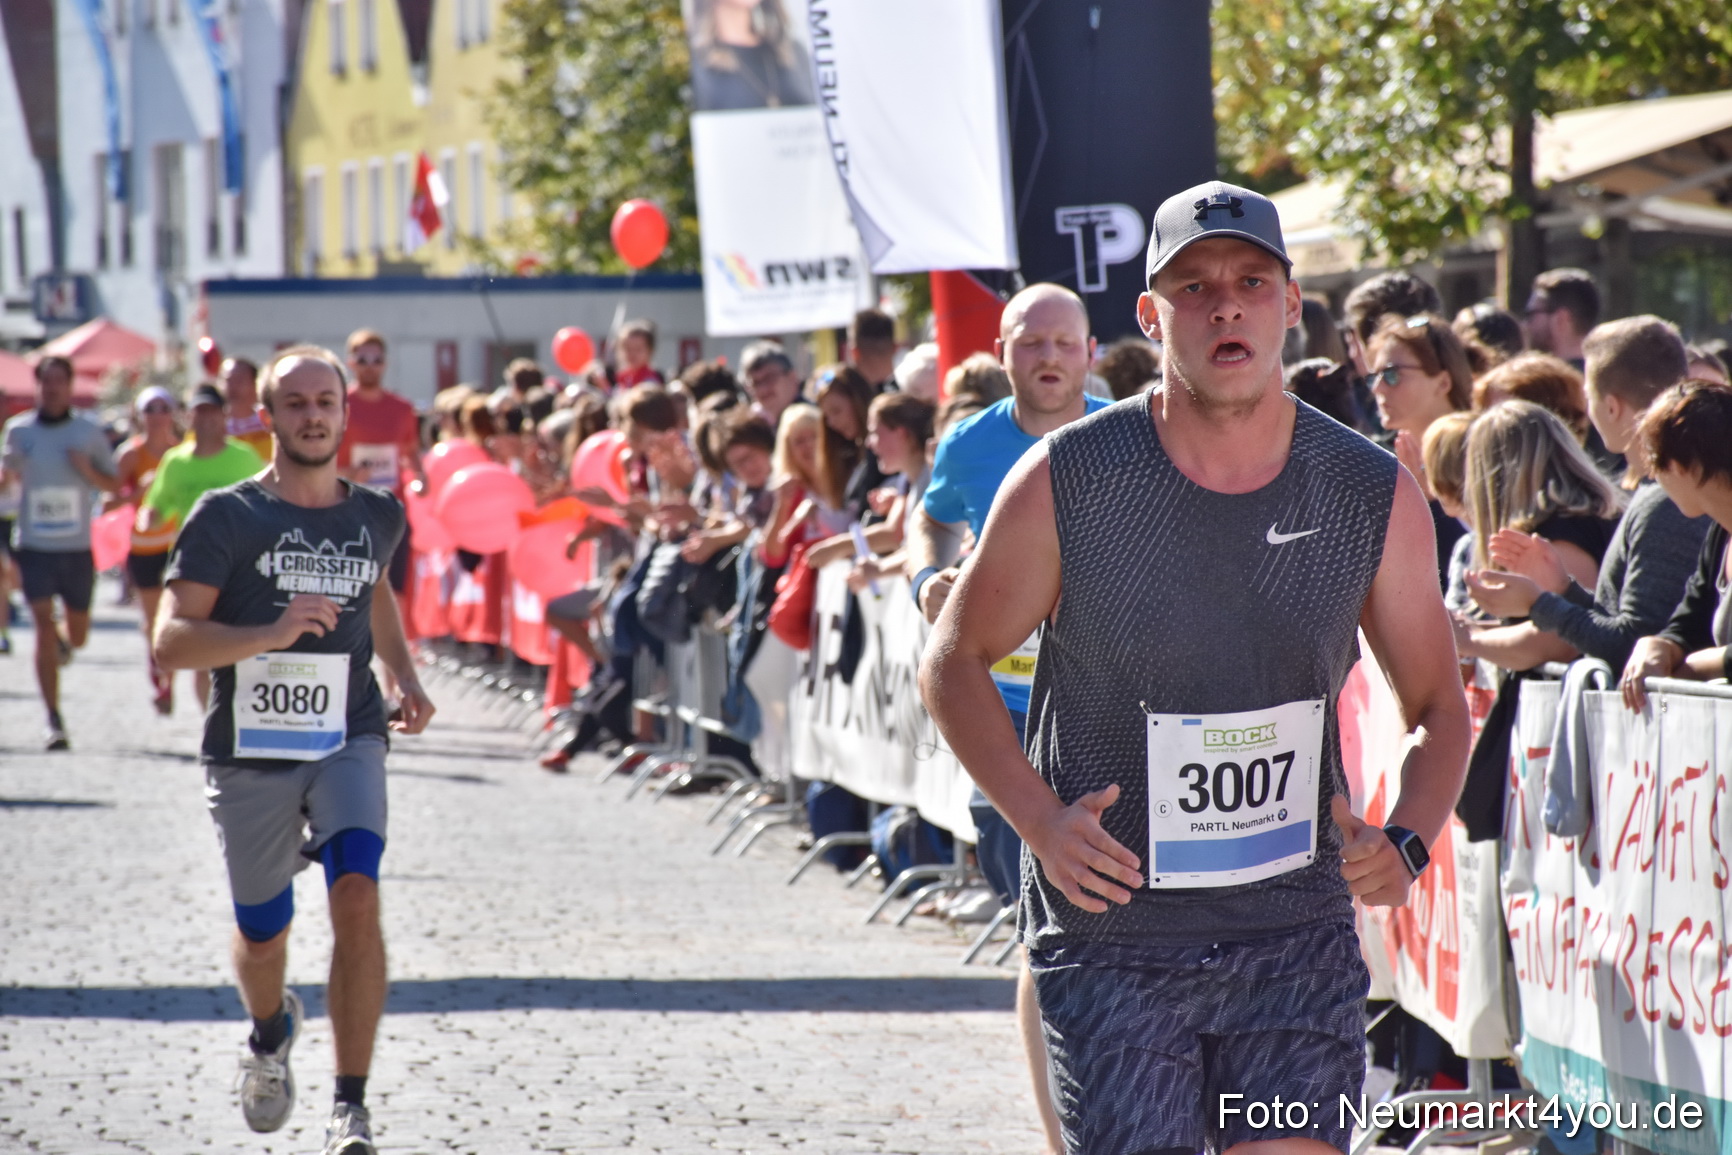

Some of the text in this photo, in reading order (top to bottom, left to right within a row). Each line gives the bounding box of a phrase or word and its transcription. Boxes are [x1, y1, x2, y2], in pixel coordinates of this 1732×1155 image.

[281, 554, 366, 579] CROSSFIT
[276, 574, 364, 598] NEUMARKT
[251, 683, 330, 715] 3080
[1203, 722, 1277, 747] BOCK
[1178, 750, 1296, 814] 3007
[1190, 814, 1275, 832] PARTL Neumarkt
